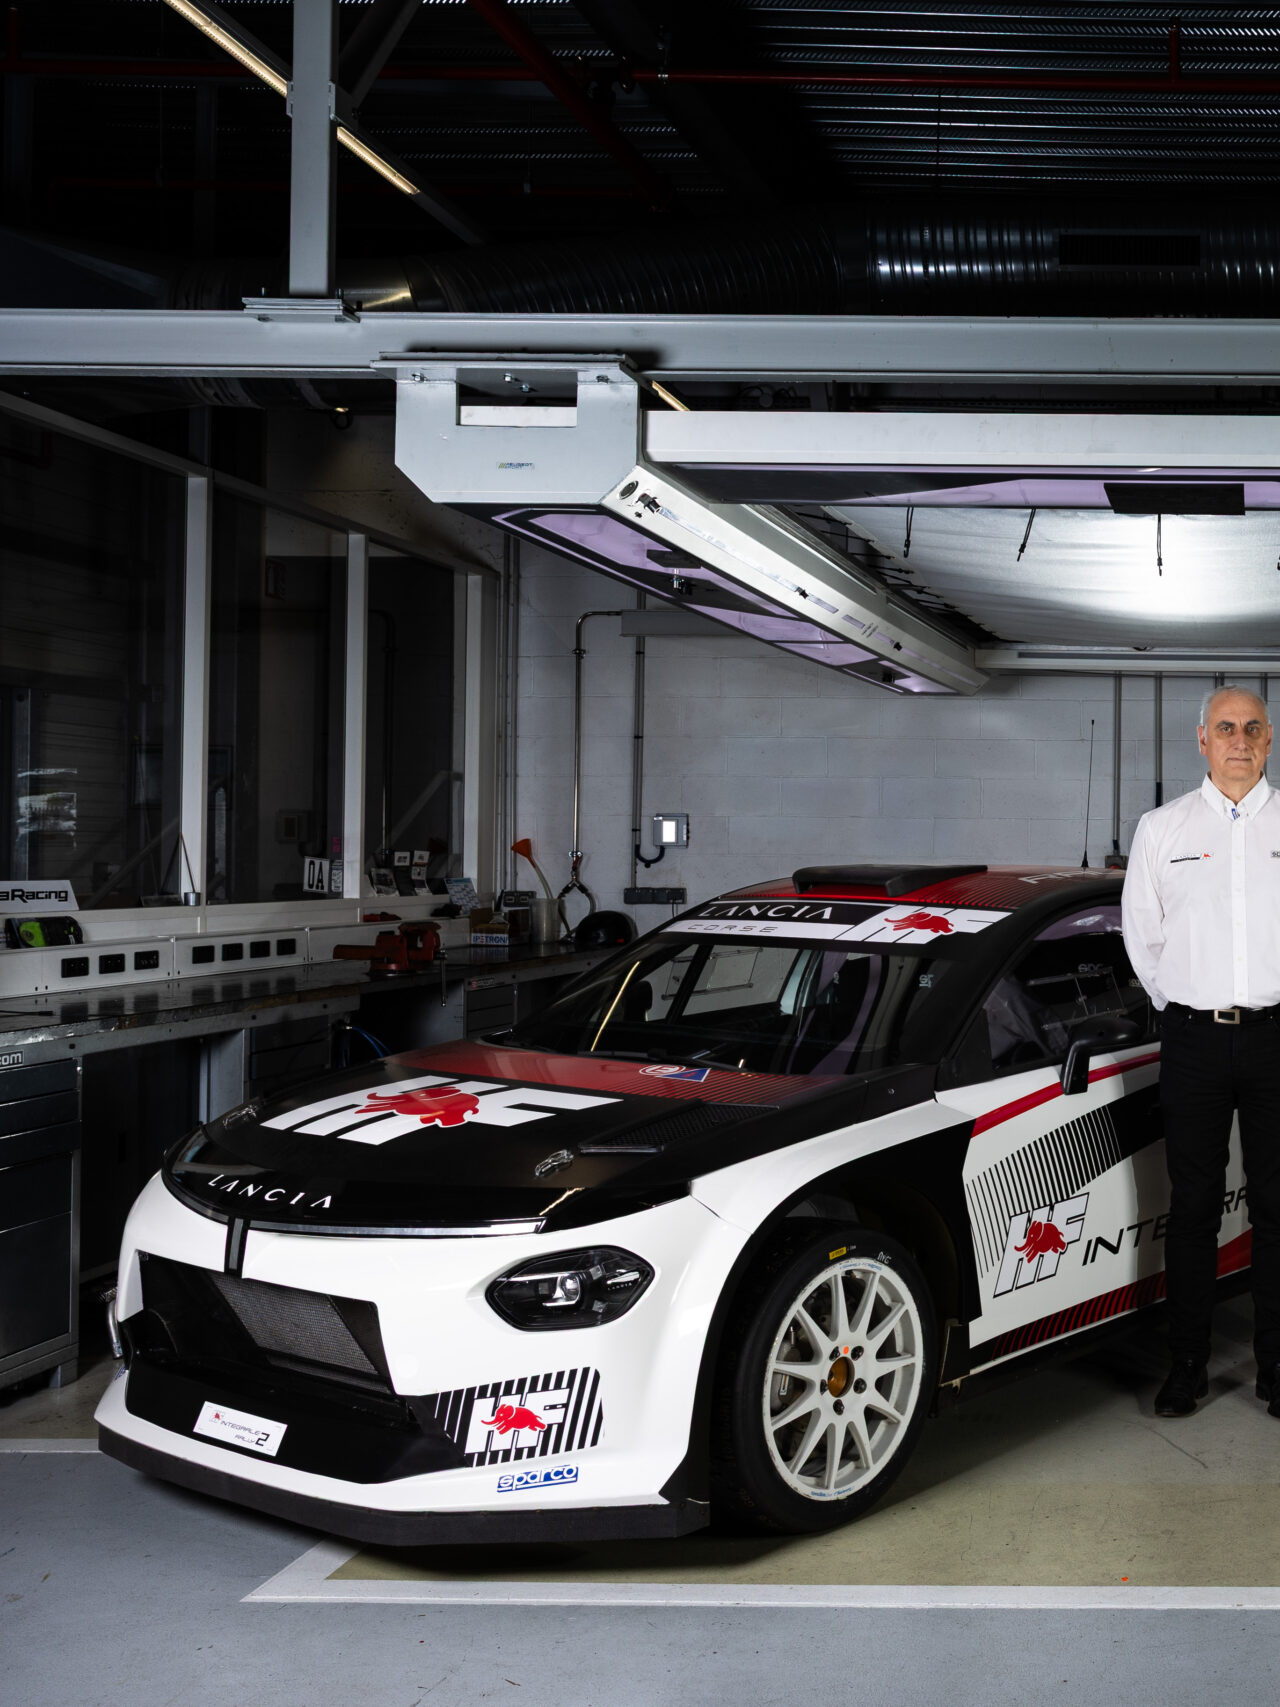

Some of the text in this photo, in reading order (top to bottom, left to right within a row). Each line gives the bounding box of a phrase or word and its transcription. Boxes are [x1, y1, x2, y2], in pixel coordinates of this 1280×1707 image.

[697, 905, 832, 919] LANCIA
[687, 924, 778, 932] CORSE
[208, 1174, 332, 1208] LANCIA
[255, 1432, 270, 1447] 2
[499, 1466, 577, 1491] sparco
